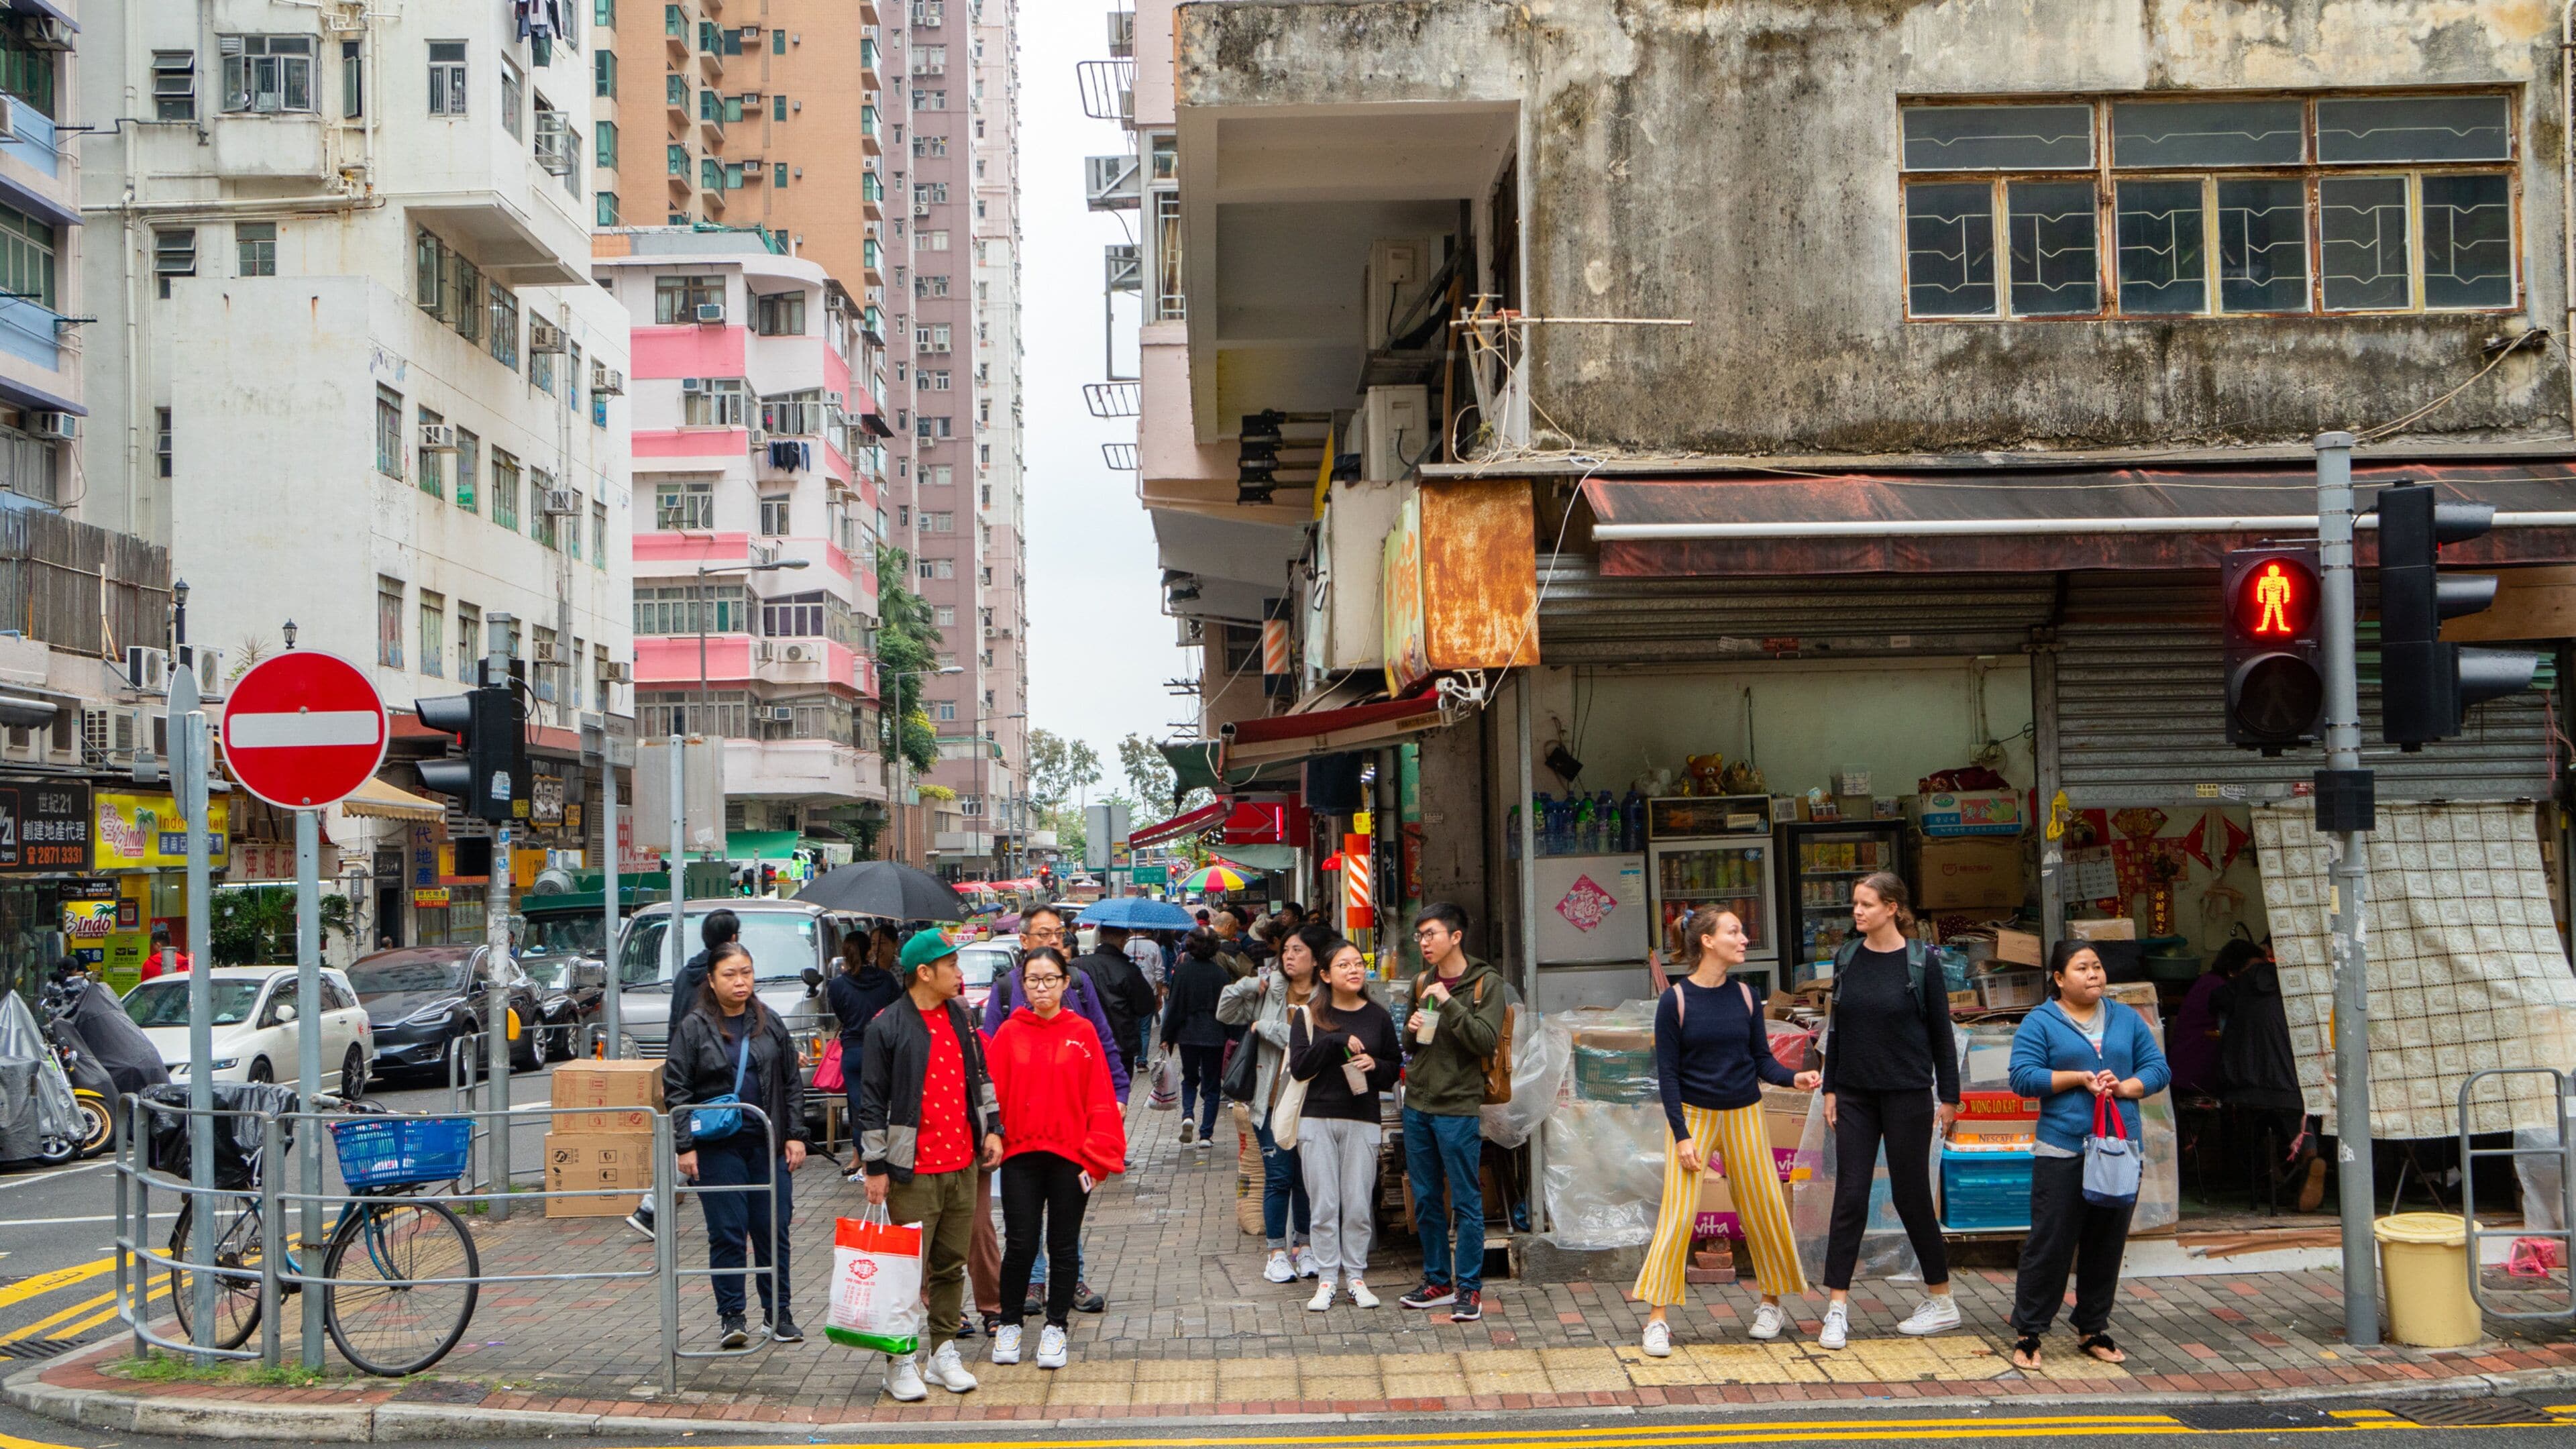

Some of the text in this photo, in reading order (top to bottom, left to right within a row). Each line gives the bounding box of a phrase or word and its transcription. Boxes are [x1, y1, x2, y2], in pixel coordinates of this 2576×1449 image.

[38, 793, 72, 813] 世紀21
[22, 820, 86, 841] 創建地產代理
[158, 814, 184, 829] Indo
[124, 825, 147, 848] Indo
[38, 847, 83, 864] 2871 3331
[77, 914, 111, 932] Indo
[1970, 1099, 2016, 1114] WONG LO KAT
[1695, 1215, 1729, 1235] vita
